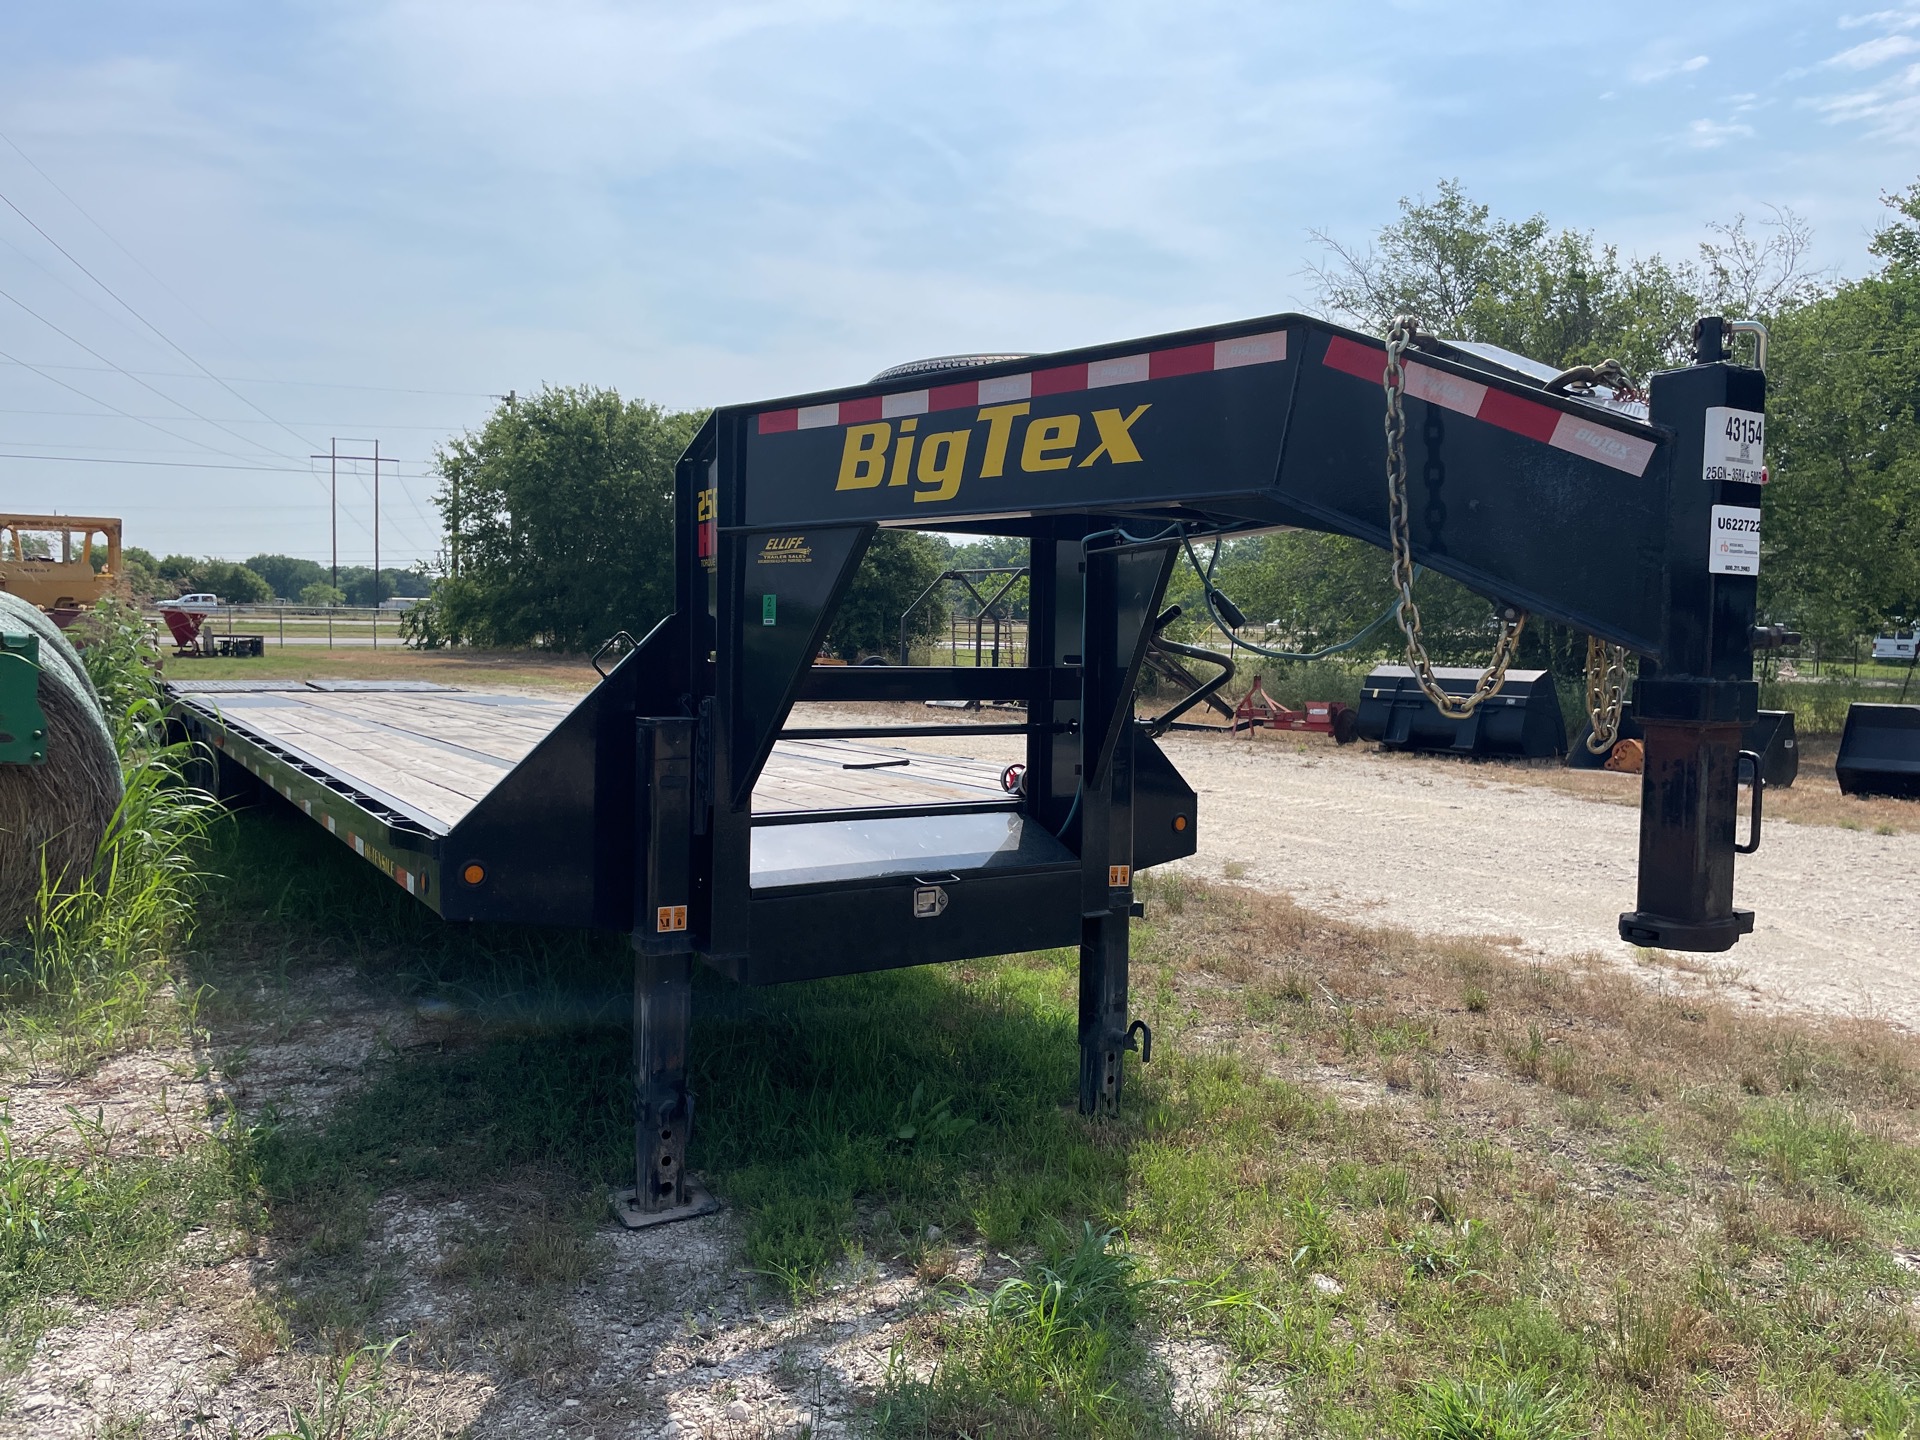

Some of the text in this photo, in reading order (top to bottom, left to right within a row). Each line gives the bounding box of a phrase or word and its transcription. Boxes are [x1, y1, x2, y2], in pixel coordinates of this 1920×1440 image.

[1725, 416, 1762, 445] 43154
[835, 402, 1153, 502] BigTex
[1717, 517, 1760, 532] U622722
[765, 537, 805, 550] ELLIFF
[767, 596, 772, 607] 2
